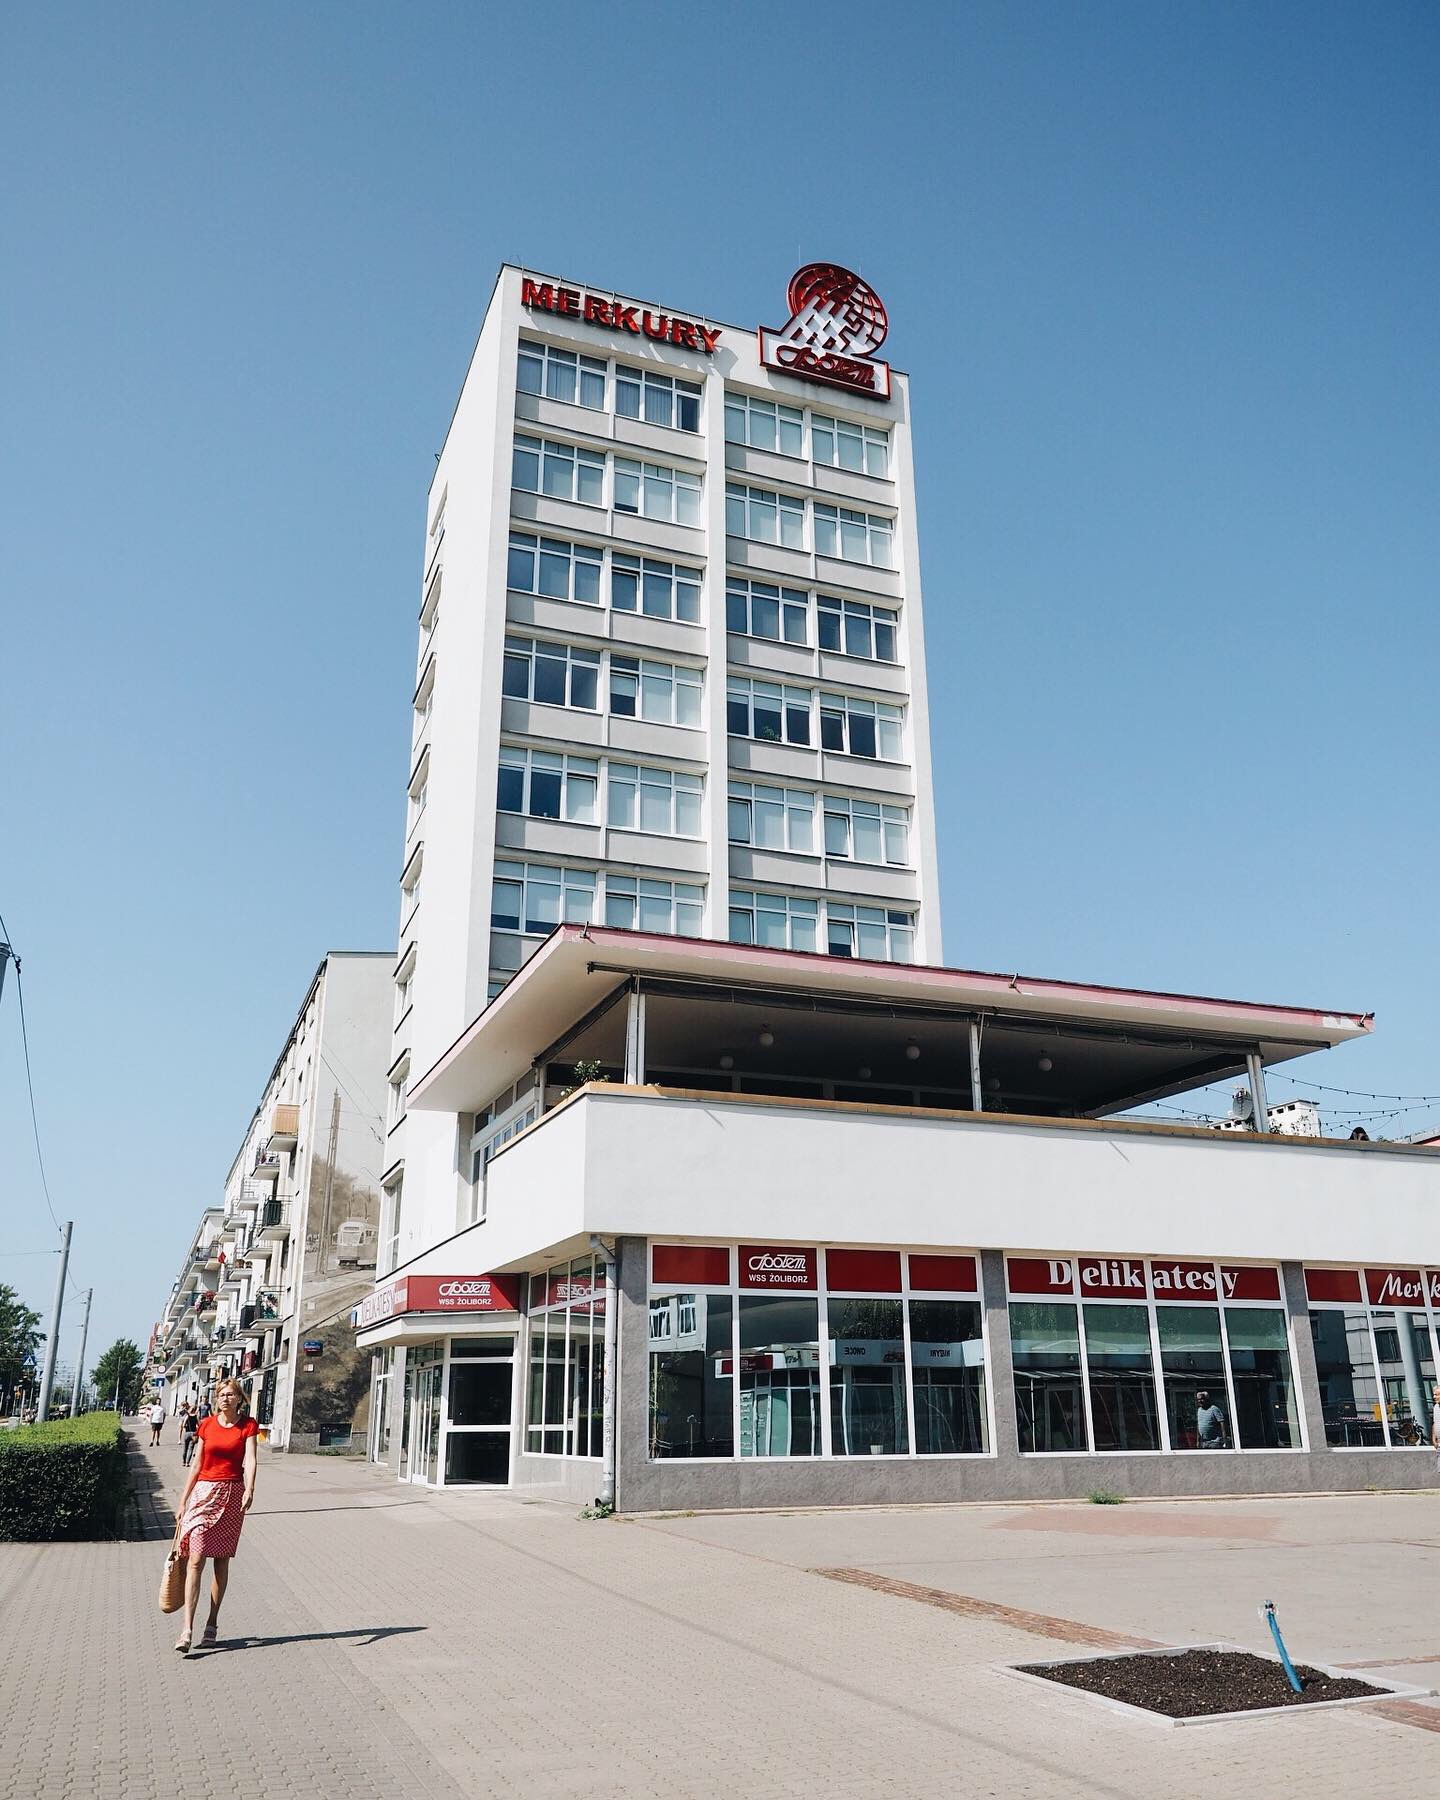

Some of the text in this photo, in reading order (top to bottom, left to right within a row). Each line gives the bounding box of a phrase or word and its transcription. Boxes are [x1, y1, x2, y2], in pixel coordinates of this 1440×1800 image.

[521, 278, 725, 354] MERKURY
[748, 1272, 808, 1283] WSS ŻOLIBORZ
[1049, 1259, 1239, 1297] Delikatesy
[438, 1297, 492, 1306] WSS ŻOLIBORZ
